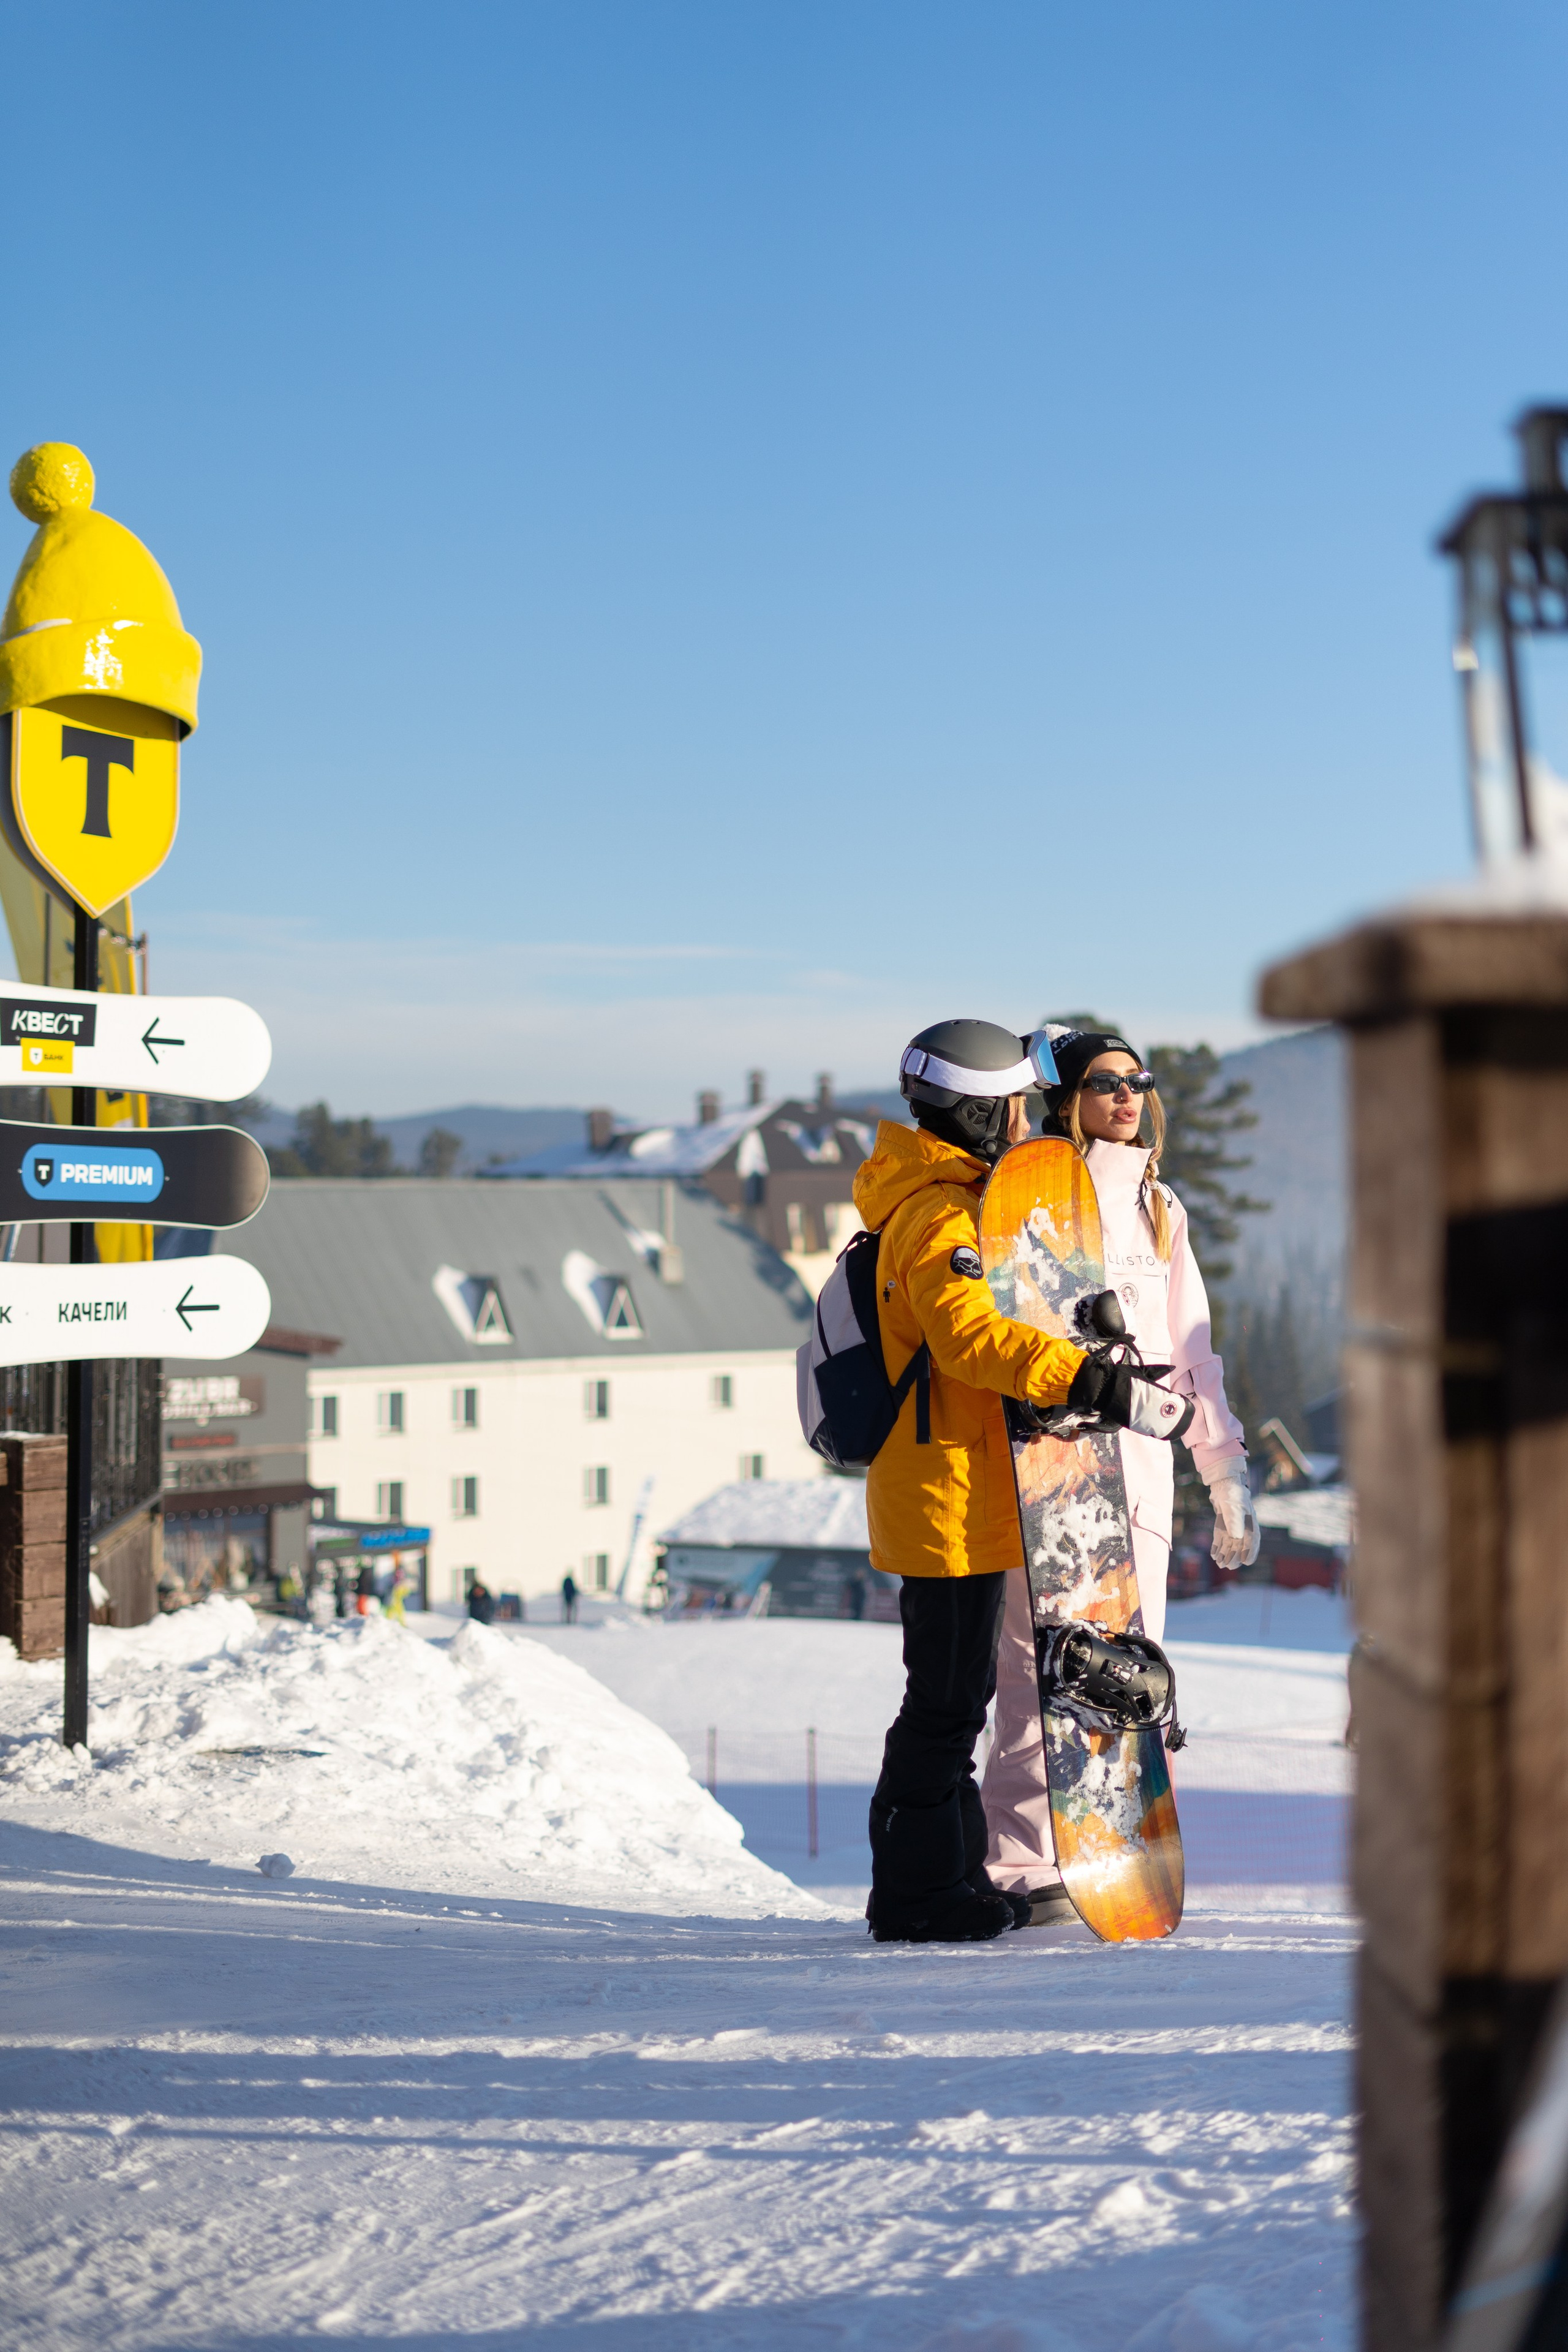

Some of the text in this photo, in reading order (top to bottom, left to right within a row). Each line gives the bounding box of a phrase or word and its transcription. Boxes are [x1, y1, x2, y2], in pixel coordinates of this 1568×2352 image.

[10, 1009, 84, 1035] КВЕСТ
[61, 1163, 153, 1186] PREMIUM
[59, 1302, 127, 1322] КАЧЕЛИ
